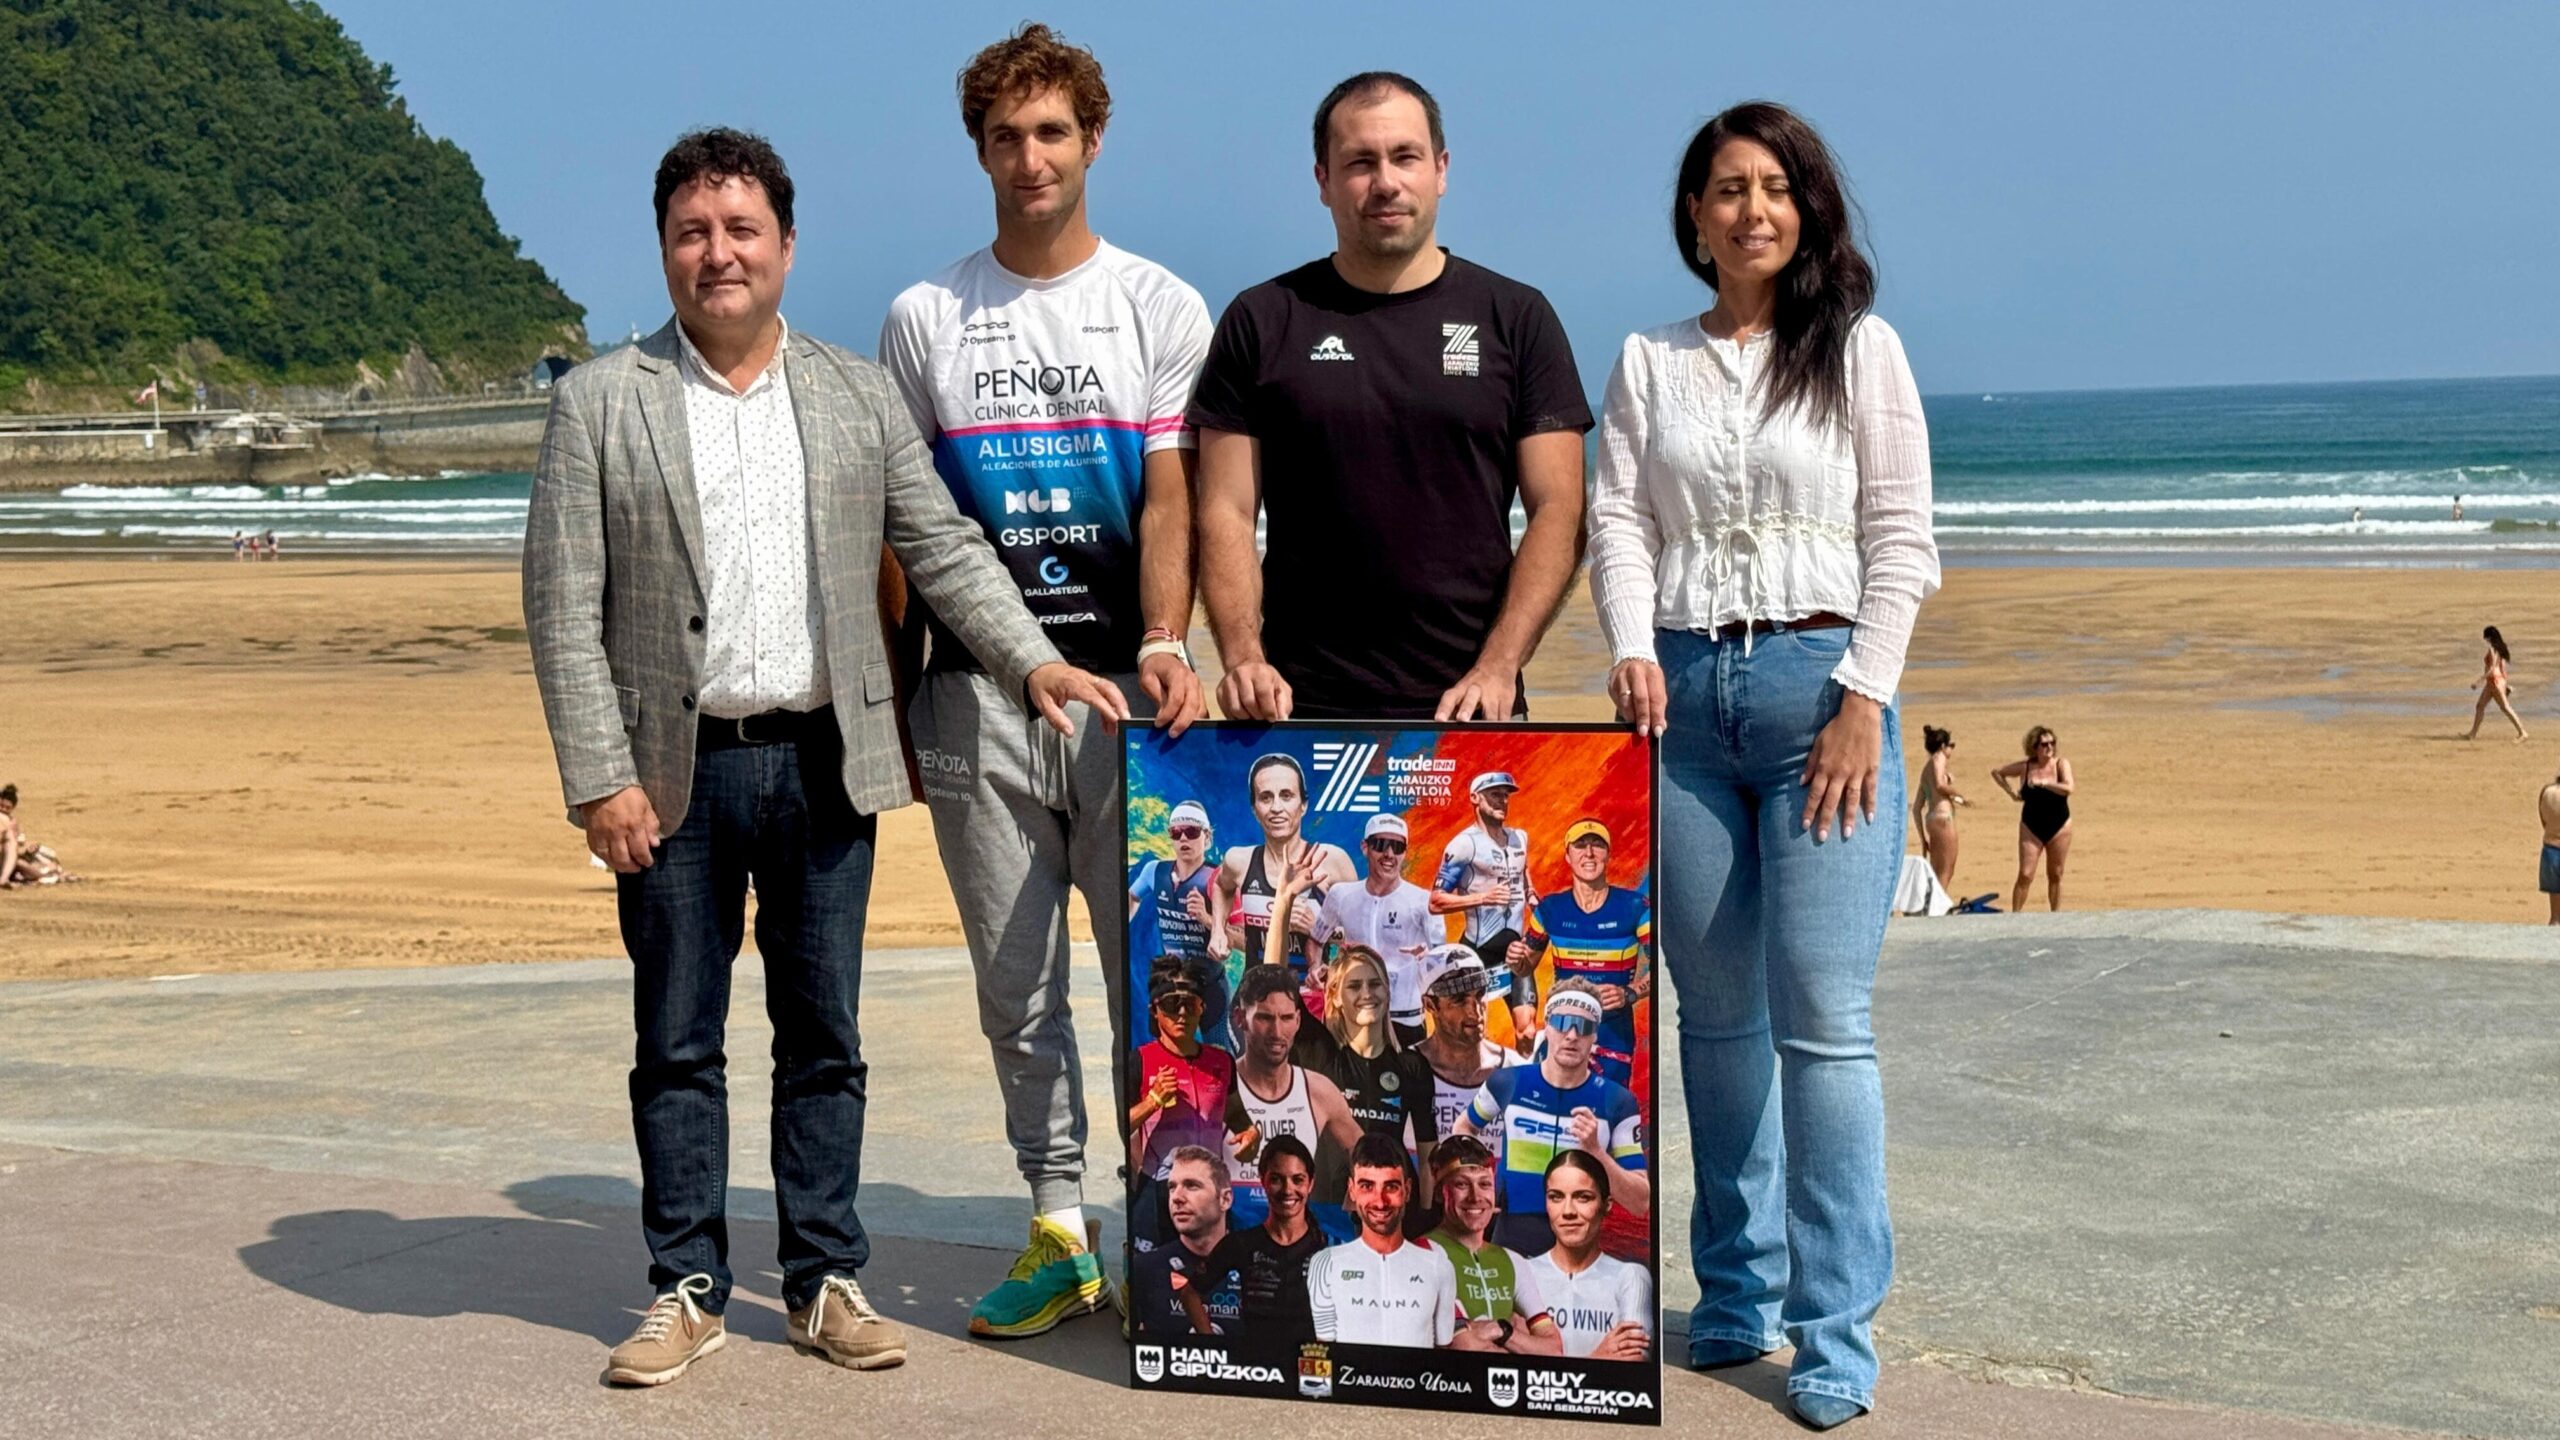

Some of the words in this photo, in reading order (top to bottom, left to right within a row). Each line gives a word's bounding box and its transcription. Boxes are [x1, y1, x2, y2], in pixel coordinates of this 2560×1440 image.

[1082, 326, 1120, 334] GSPORT
[975, 359, 1105, 399] PEÑOTA
[975, 401, 1041, 421] CLÍNICA
[1046, 398, 1107, 418] DENTAL
[978, 432, 1107, 459] ALUSIGMA
[982, 459, 1045, 472] ALEACIONES
[1047, 459, 1061, 468] DE
[1063, 456, 1108, 468] ALUMINIO
[1000, 524, 1101, 547] GSPORT
[1024, 585, 1088, 597] GALLASTEGUI
[1038, 612, 1097, 625] RBEA
[1388, 775, 1452, 785] ZARAUZKO
[1388, 786, 1452, 796] TRIATLOIA
[1388, 797, 1422, 806] SINCE
[1427, 798, 1452, 806] 1987
[1351, 1297, 1420, 1308] MAUNA
[1572, 1308, 1614, 1333] WNIK
[1170, 1347, 1228, 1364] HAIN
[1169, 1362, 1285, 1383] GIPUZKOA
[1526, 1369, 1587, 1388] MUY
[1525, 1386, 1654, 1409] GIPUZKOA
[1527, 1402, 1552, 1411] SAN
[1554, 1403, 1619, 1416] SEBASTIÁN
